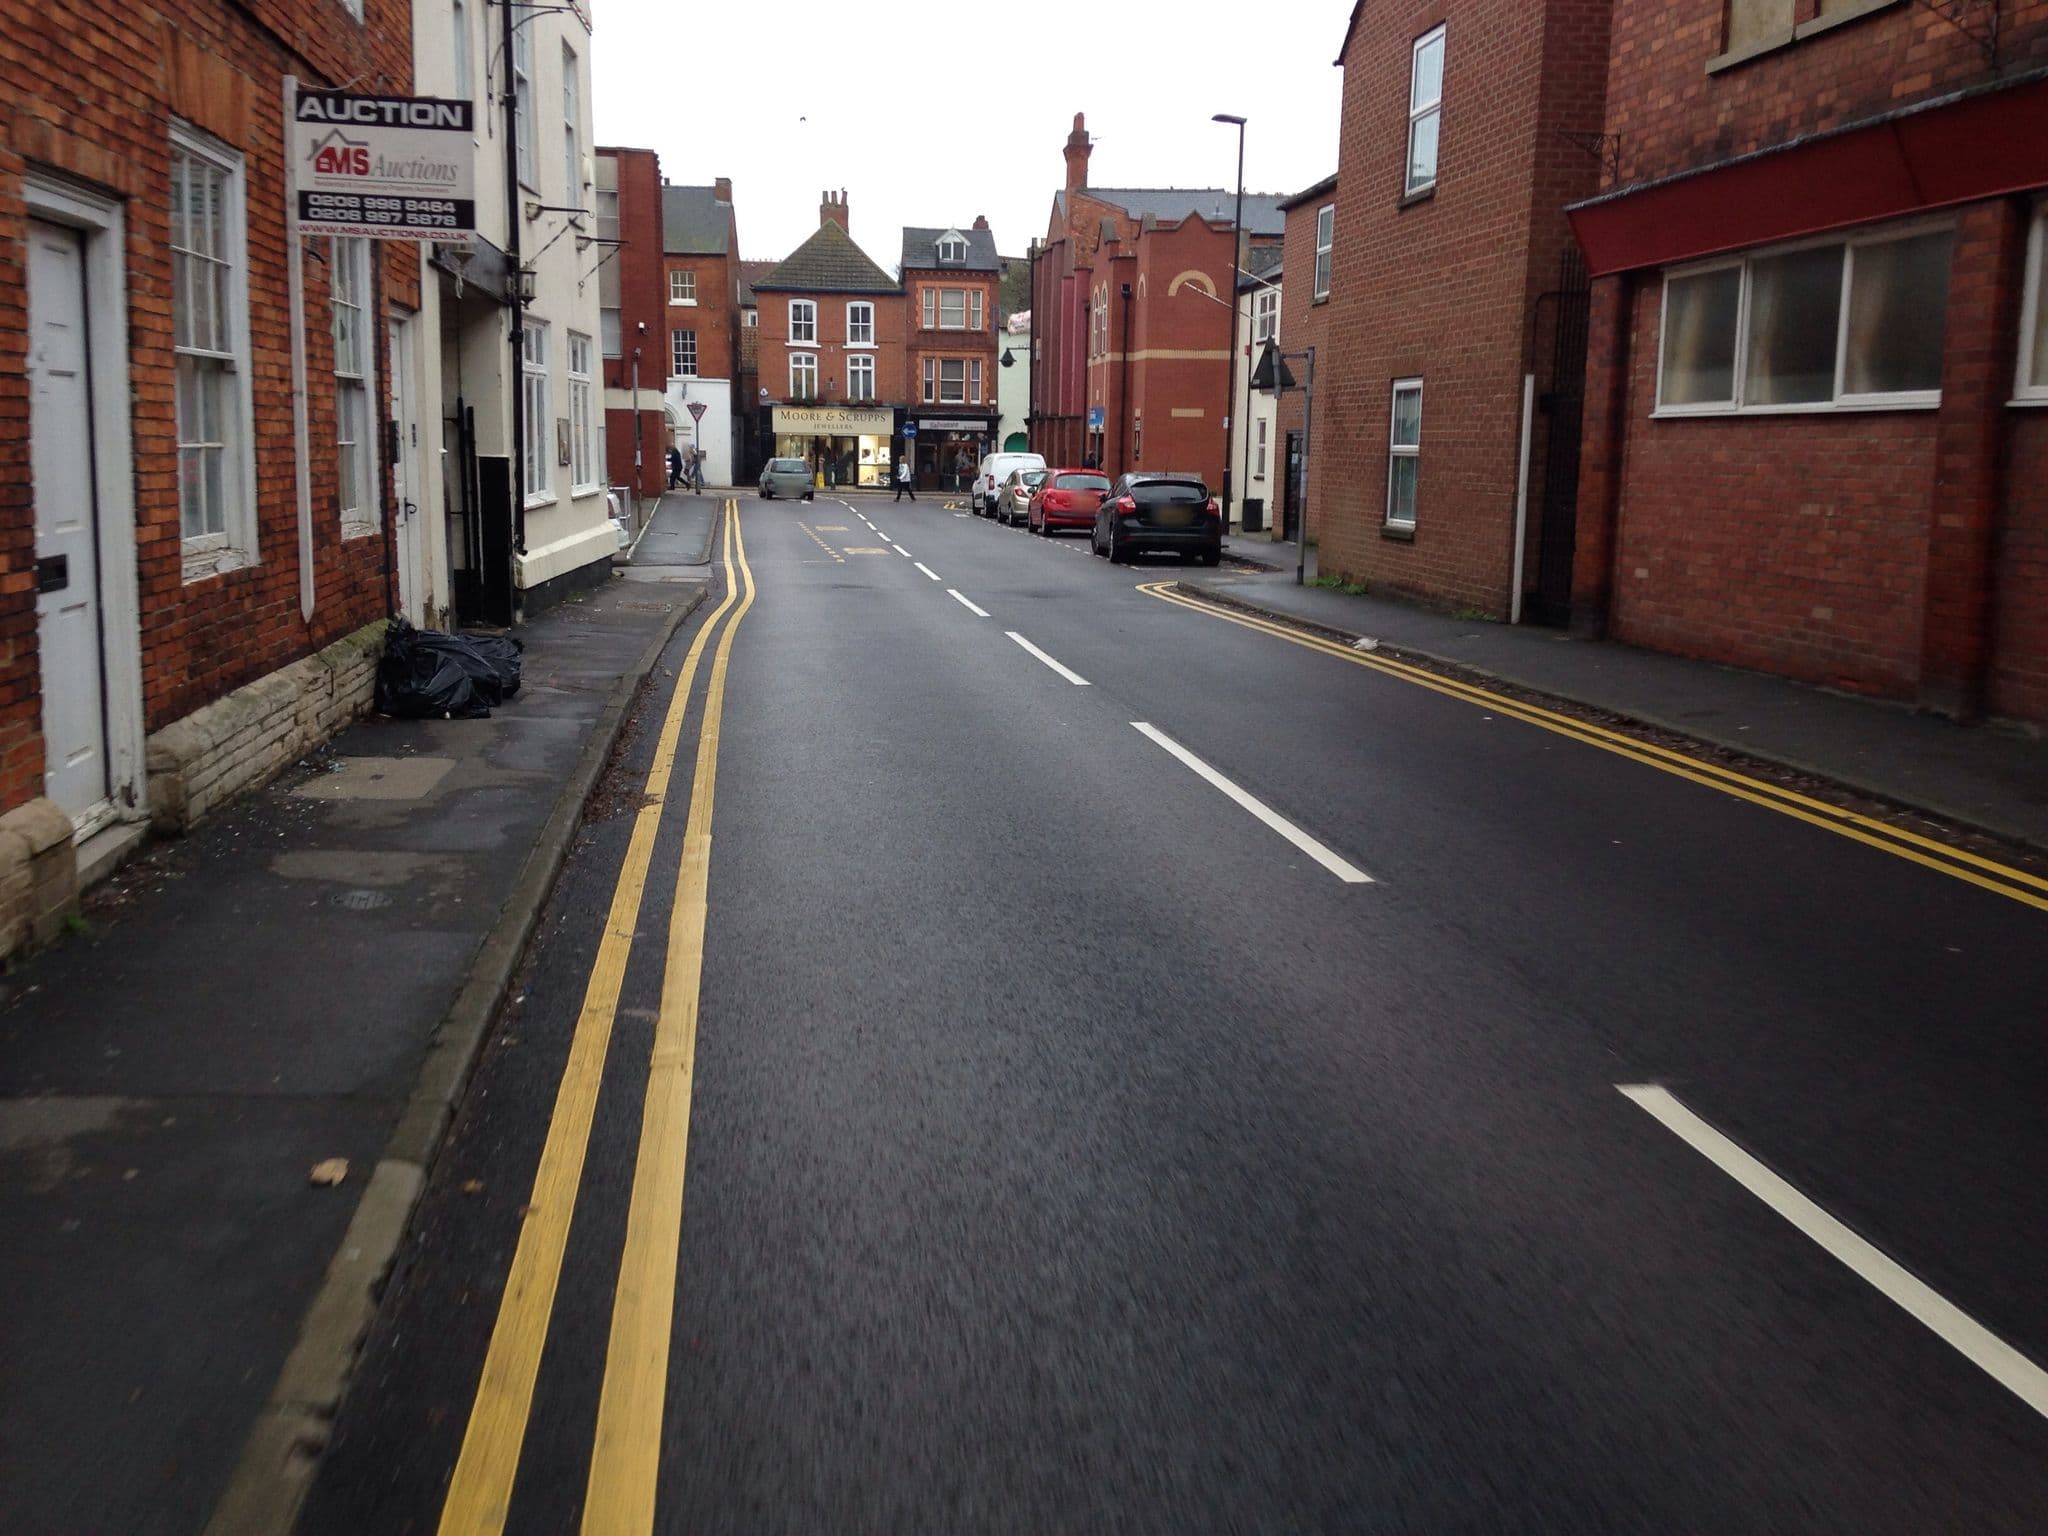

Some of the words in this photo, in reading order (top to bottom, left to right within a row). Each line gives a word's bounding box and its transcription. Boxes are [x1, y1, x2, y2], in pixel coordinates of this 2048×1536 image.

[299, 97, 464, 128] AUCTION
[370, 152, 459, 182] Auctions
[308, 194, 361, 208] 0208
[308, 208, 362, 221] 0208
[365, 210, 402, 223] 997
[299, 225, 469, 240] WWW.MSAUCTIONS.CO.UK
[780, 410, 822, 421] MOORE
[825, 411, 835, 422] &
[839, 411, 887, 423] SCRUPPS
